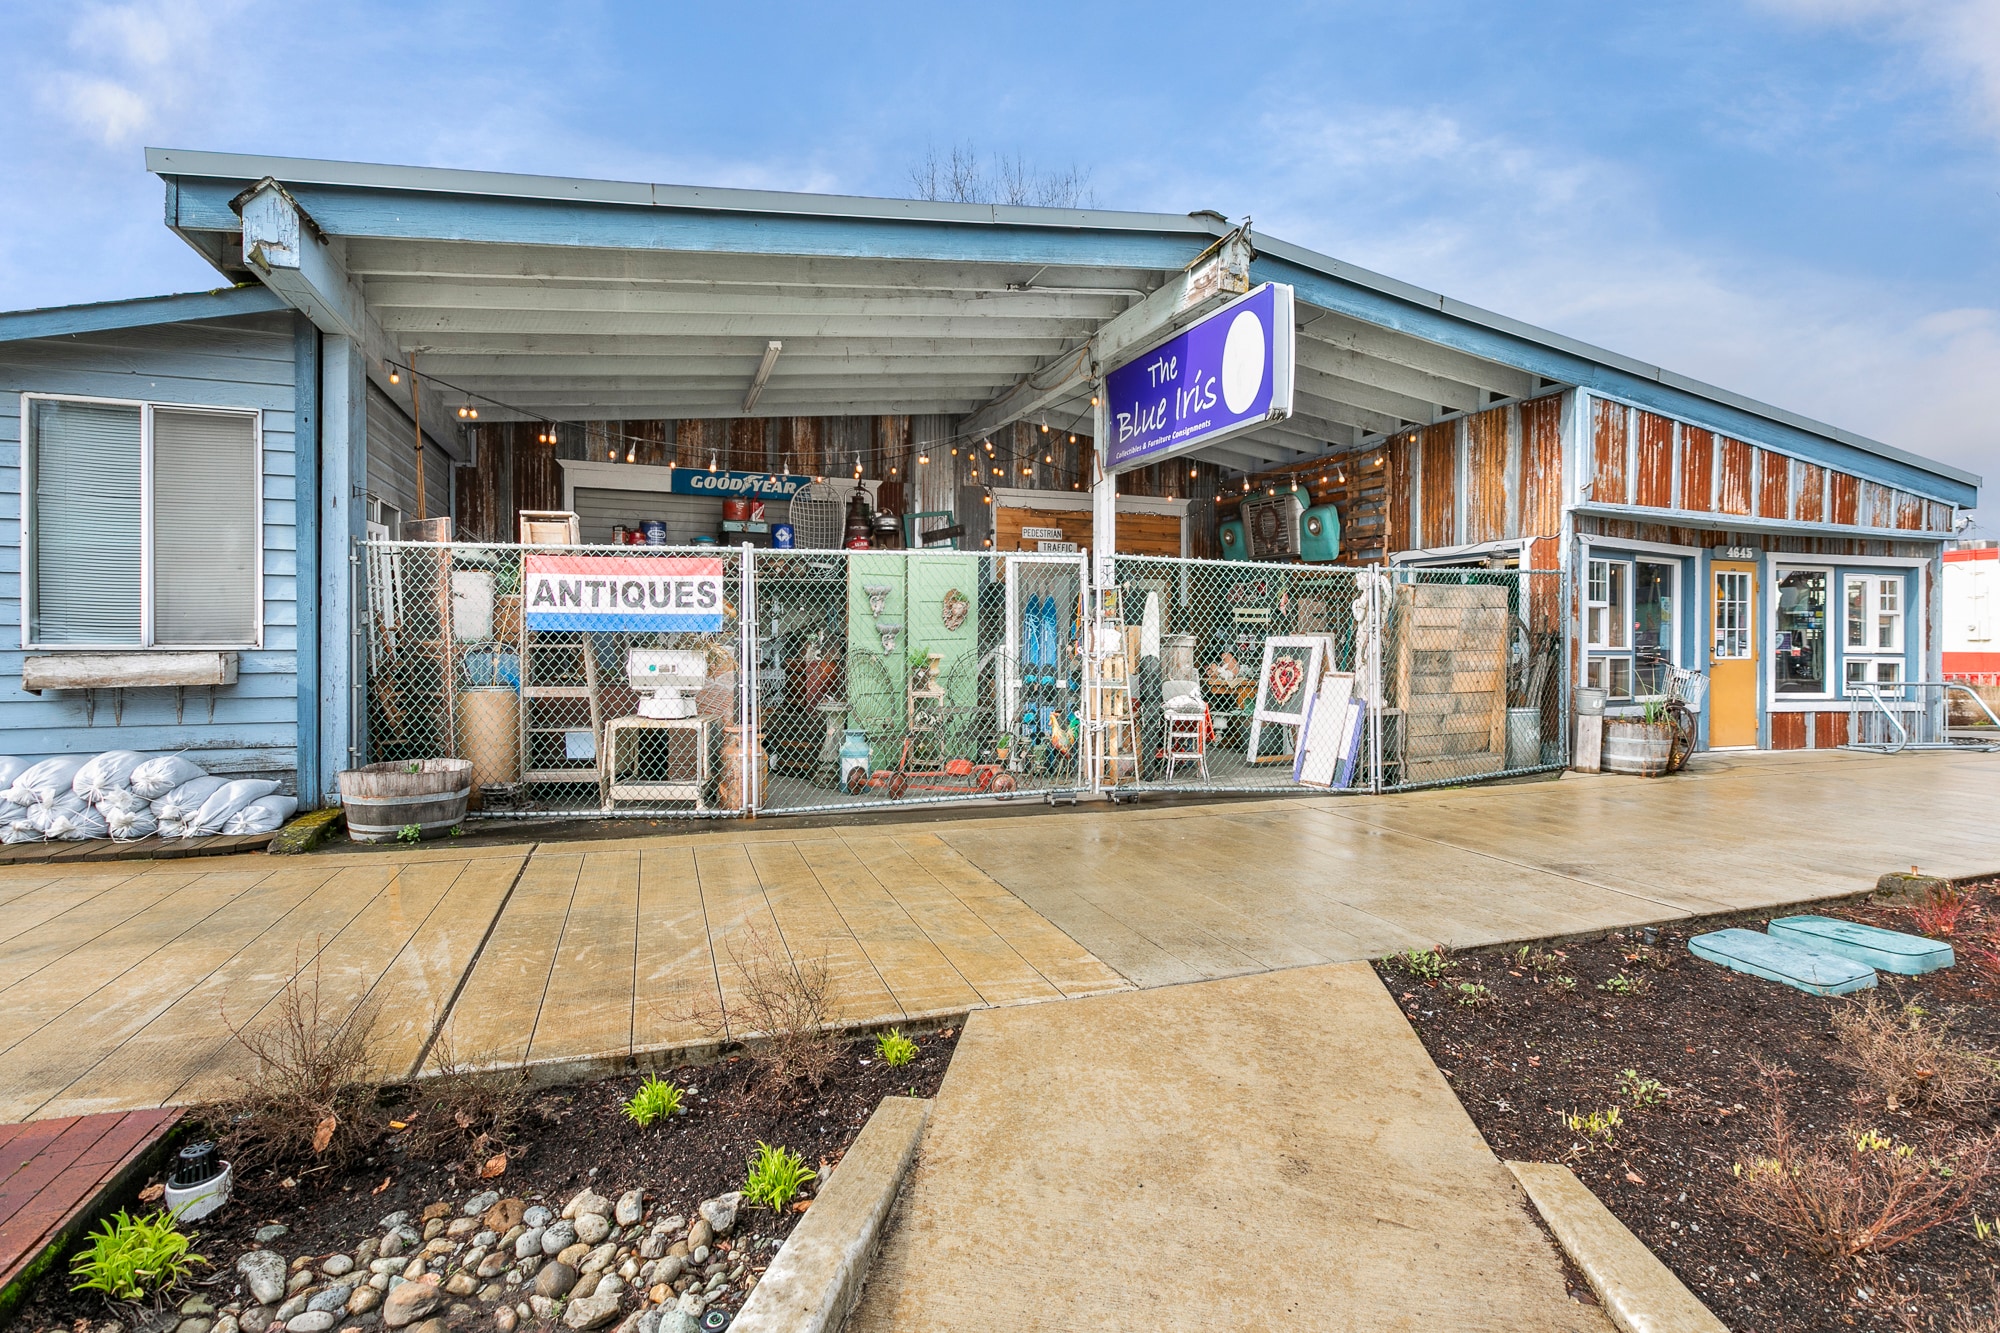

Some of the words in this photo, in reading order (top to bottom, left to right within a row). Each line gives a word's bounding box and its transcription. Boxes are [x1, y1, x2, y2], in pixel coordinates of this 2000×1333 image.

[1147, 356, 1178, 388] The
[1116, 397, 1167, 444] Blue
[1175, 369, 1217, 421] Iris
[1115, 445, 1142, 460] Collectibles
[1147, 434, 1172, 448] Furniture
[1172, 419, 1212, 439] Consignments
[690, 474, 797, 495] GOODYEAR
[1023, 528, 1062, 538] PEDESTRIAN
[1043, 542, 1073, 552] TRAFFIC
[1726, 546, 1753, 559] 4645
[532, 579, 717, 610] ANTIQUES
